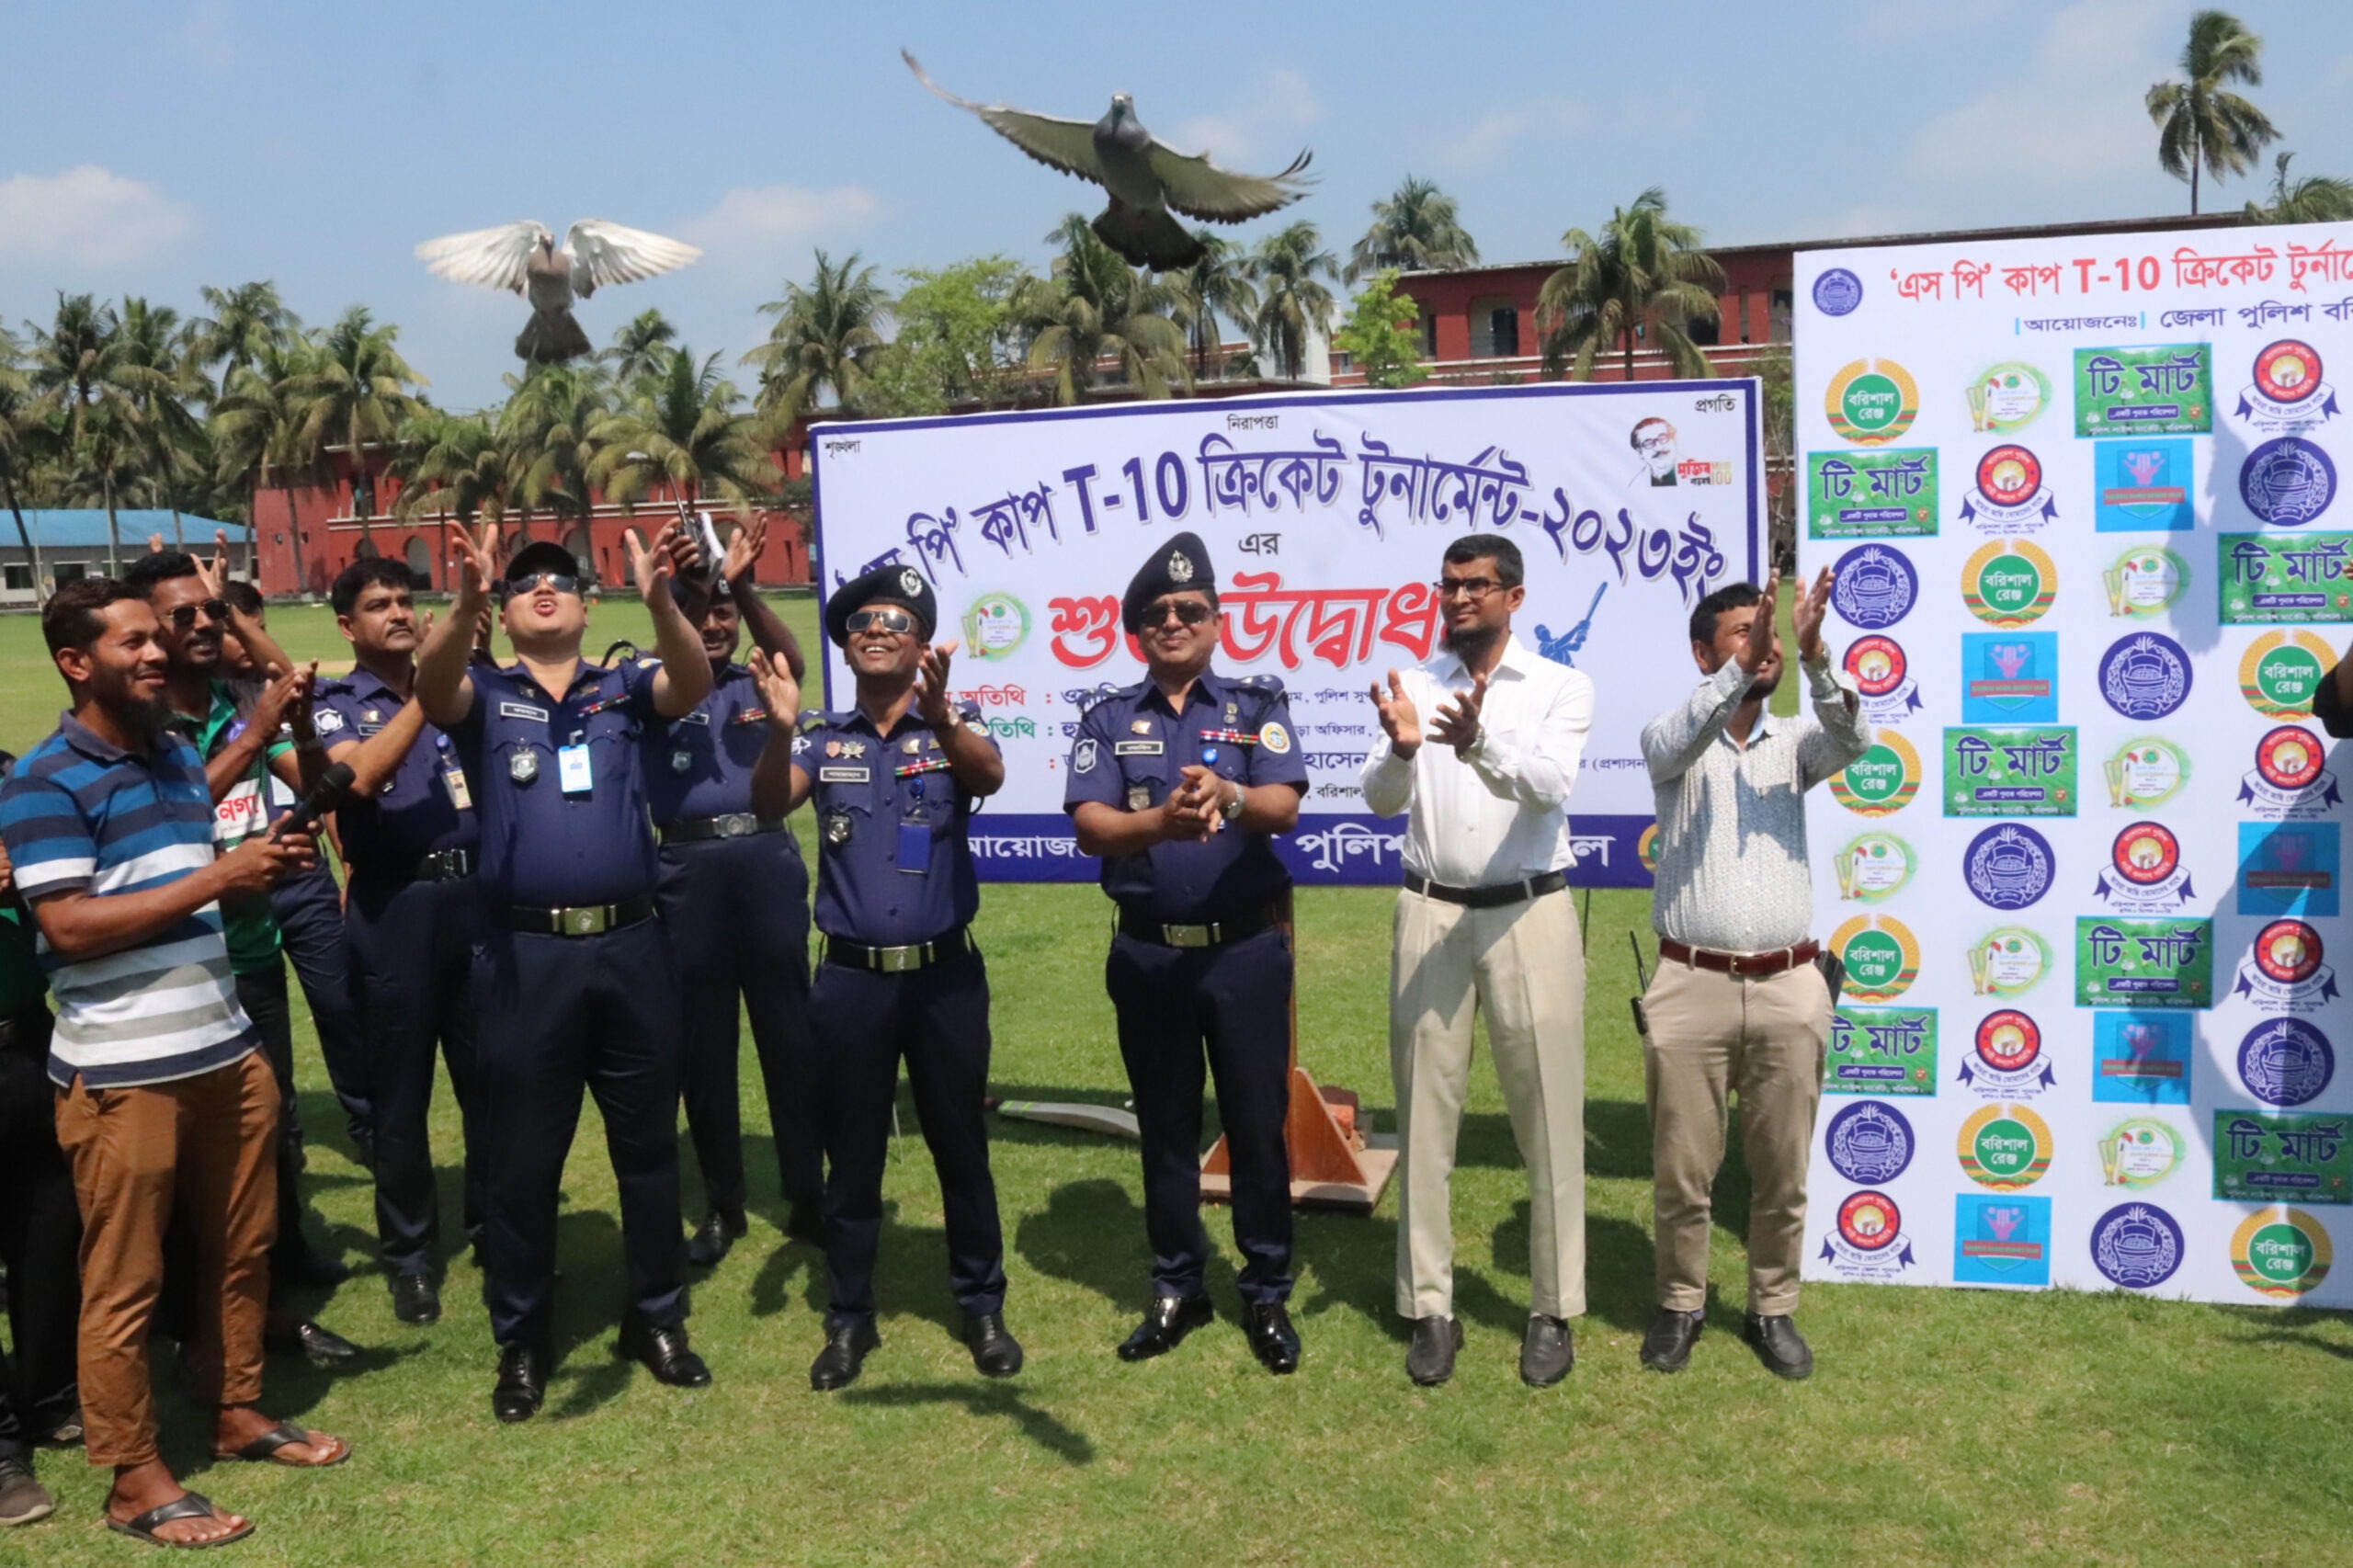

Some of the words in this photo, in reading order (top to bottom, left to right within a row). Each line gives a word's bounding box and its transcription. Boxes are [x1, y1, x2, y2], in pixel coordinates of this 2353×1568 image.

[2001, 262, 2063, 297] কাপ
[2073, 257, 2161, 293] T-10
[2171, 246, 2279, 288] ক্রিকেট
[2160, 307, 2226, 327] জেলা
[2238, 300, 2313, 329] পুলিশ
[2086, 356, 2124, 398] টি
[2135, 351, 2201, 395] মার্ট
[1695, 393, 1736, 413] প্রগতি
[1848, 390, 1894, 406] বরিশাল
[1859, 406, 1884, 420] রেঞ্জ
[1227, 414, 1279, 431] নিরাপত্তা
[1819, 459, 1857, 500] টি
[1866, 456, 1928, 499] মার্ট
[970, 480, 1058, 555] কাপ
[1063, 450, 1188, 533] T-10
[1197, 429, 1347, 517] ক্রিকেট
[1238, 532, 1280, 555] এর
[2231, 541, 2271, 584] টি
[2281, 539, 2349, 584] মার্ট
[1985, 571, 2032, 587] বরিশাল
[1995, 587, 2022, 602] রেঞ্জ
[2264, 662, 2313, 680] বরিশাল
[1314, 688, 1349, 704] পুলিশ
[2276, 680, 2303, 695] রেঞ্জ
[1954, 735, 1993, 778] টি
[2003, 734, 2067, 778] মার্ট
[1851, 760, 1897, 777] বরিশাল
[1861, 777, 1887, 791] রেঞ্জ
[1849, 946, 1896, 962] বরিশাল
[2088, 925, 2126, 968] টি
[2136, 926, 2203, 970] মার্ট
[1859, 962, 1885, 977] রেঞ্জ
[1865, 1016, 1927, 1058] মার্ট
[1981, 1134, 2029, 1151] বরিশাল
[2225, 1119, 2266, 1160] টি
[2277, 1121, 2343, 1164] মার্ট
[1991, 1151, 2018, 1165] রেঞ্জ
[2255, 1239, 2306, 1257] বরিশাল
[2267, 1256, 2294, 1271] রেঞ্জ
